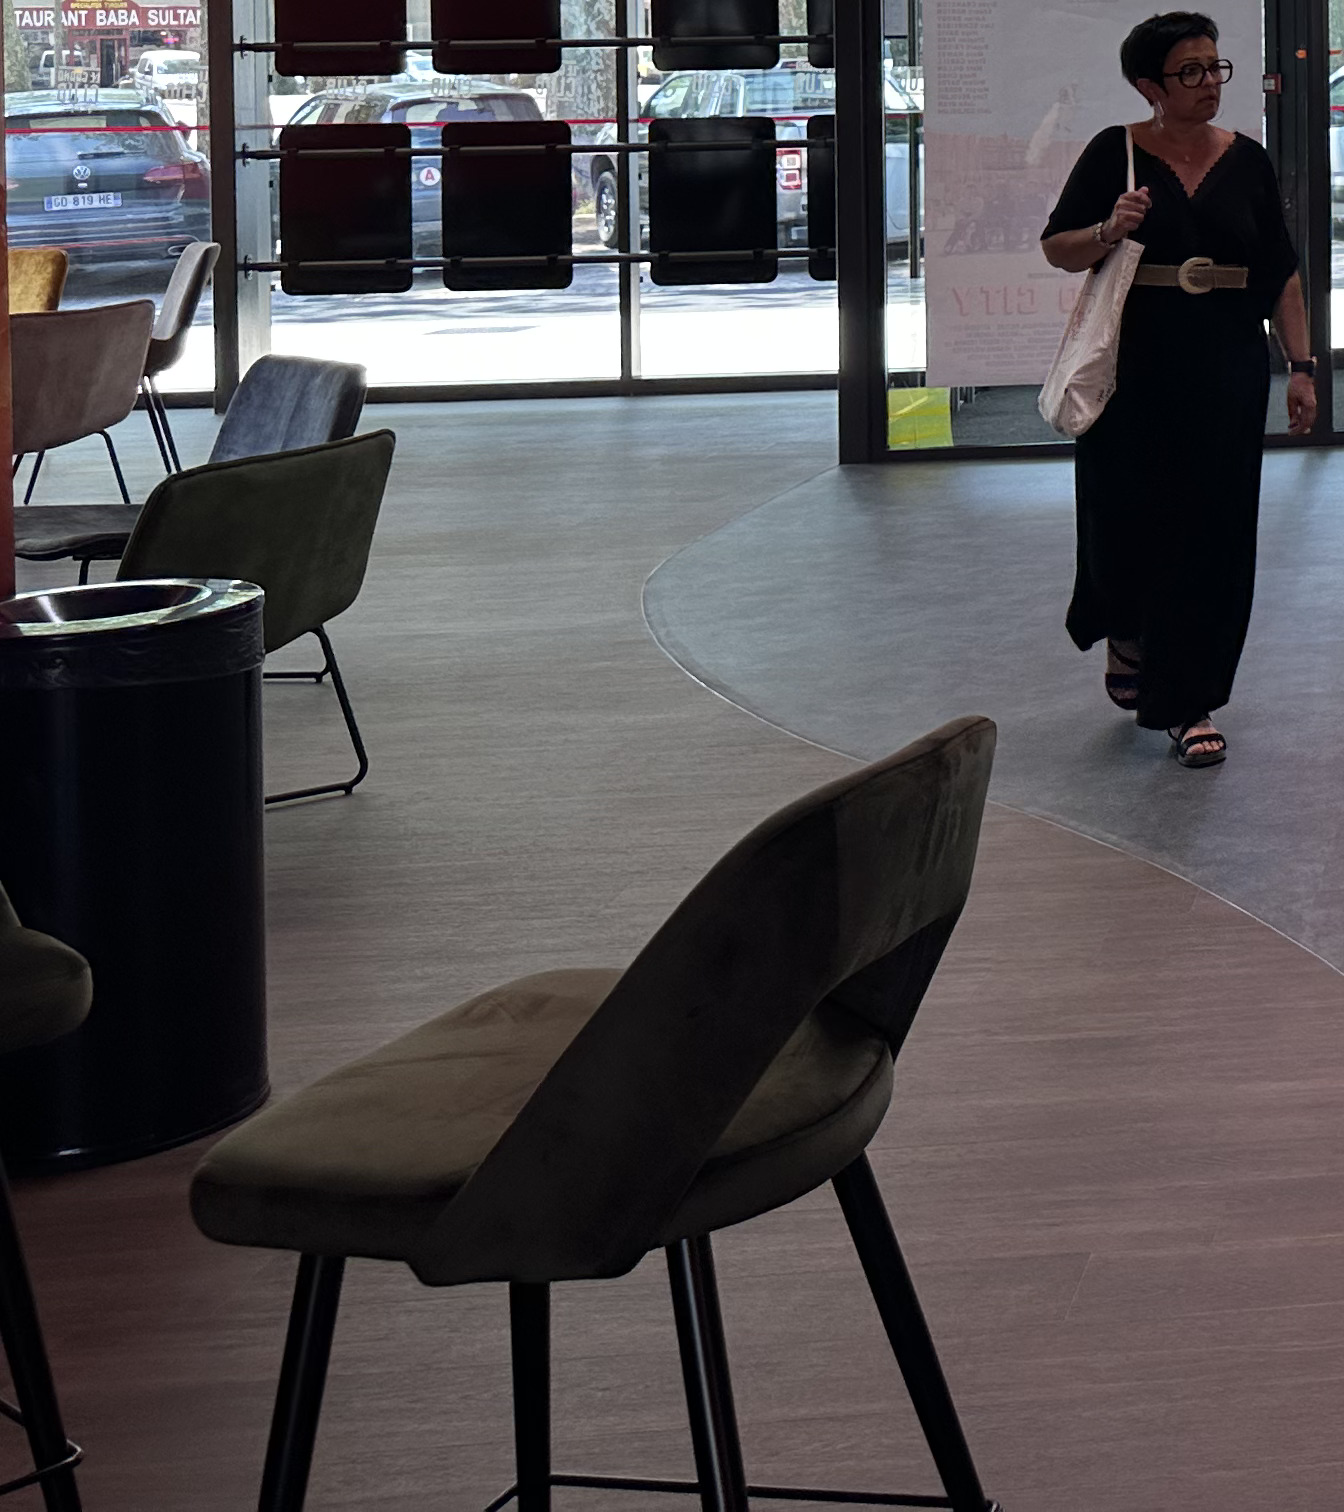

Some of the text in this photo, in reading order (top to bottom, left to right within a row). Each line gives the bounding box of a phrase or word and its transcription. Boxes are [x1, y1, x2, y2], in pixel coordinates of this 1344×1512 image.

[15, 10, 88, 27] TAURANT
[96, 10, 140, 27] BABA
[72, 195, 94, 207] 819
